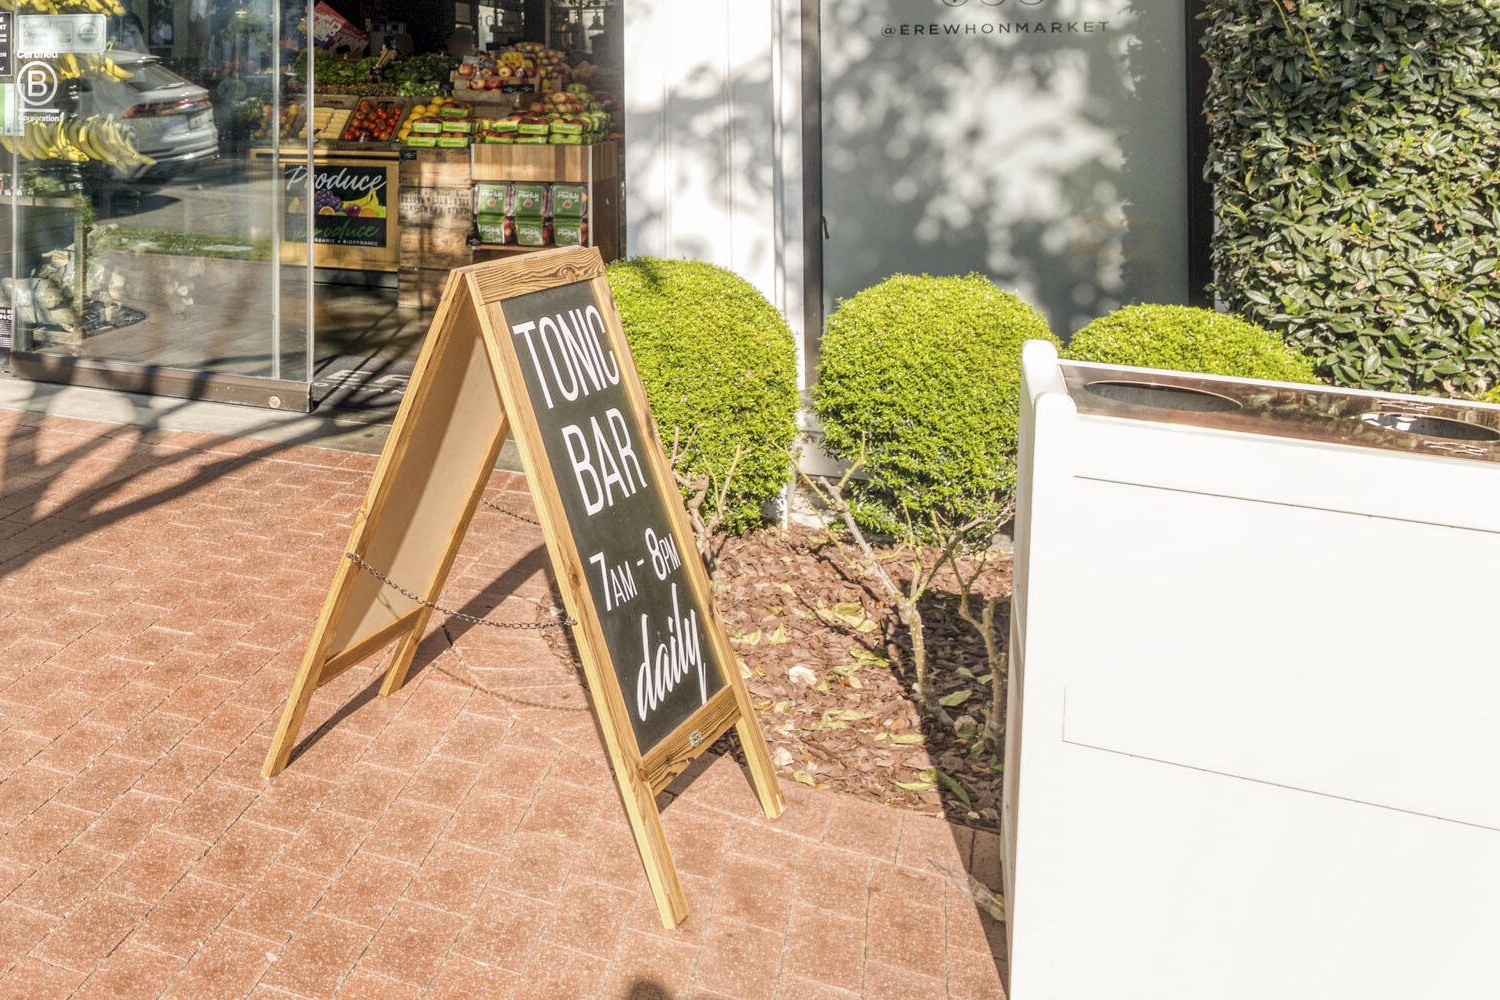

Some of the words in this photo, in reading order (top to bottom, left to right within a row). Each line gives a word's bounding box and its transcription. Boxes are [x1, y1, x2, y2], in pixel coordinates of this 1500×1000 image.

[881, 21, 1110, 38] @EREWHONMARKET
[512, 305, 621, 409] TONIC
[561, 407, 648, 516] BAR
[589, 551, 638, 612] 7AM
[644, 527, 681, 582] 8PM
[636, 582, 707, 722] daily
